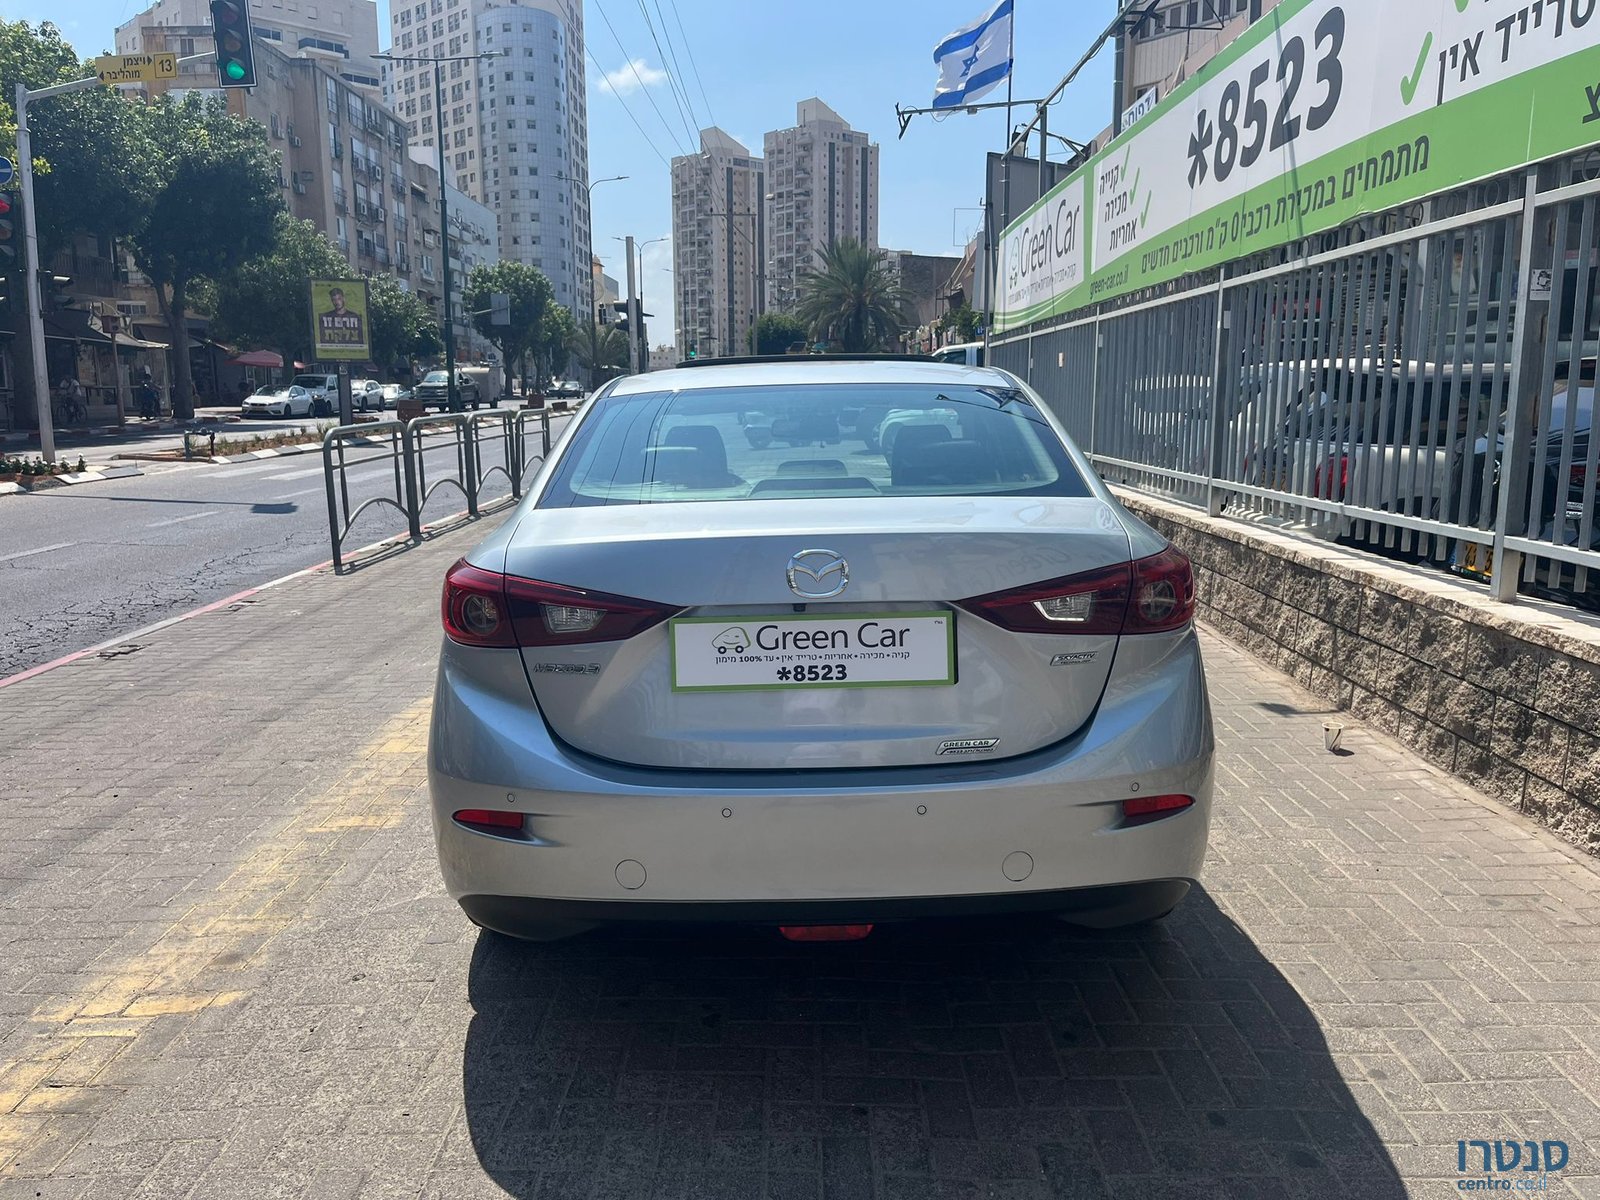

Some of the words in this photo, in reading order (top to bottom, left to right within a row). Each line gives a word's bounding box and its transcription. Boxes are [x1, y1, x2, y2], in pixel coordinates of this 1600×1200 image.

[123, 56, 146, 69] ויצמן
[158, 59, 173, 73] 13
[1436, 30, 1485, 106] אין
[1100, 164, 1119, 196] קנייה
[1342, 135, 1430, 200] מתמחים
[1105, 191, 1127, 222] מכירה
[1274, 175, 1336, 227] במכירת
[1020, 224, 1053, 278] Green
[1055, 199, 1080, 258] Car
[1109, 217, 1138, 251] אחריות
[1172, 230, 1204, 262] ורכבים
[1141, 245, 1170, 274] חדשים
[756, 624, 849, 651] Green
[857, 621, 910, 648] Car
[715, 656, 737, 664] מימון
[739, 655, 763, 663] 100%
[781, 654, 793, 663] אין
[796, 653, 817, 662] טרייד
[824, 653, 853, 661] אחריות
[860, 651, 885, 660] מכירה
[891, 651, 910, 660] קניה
